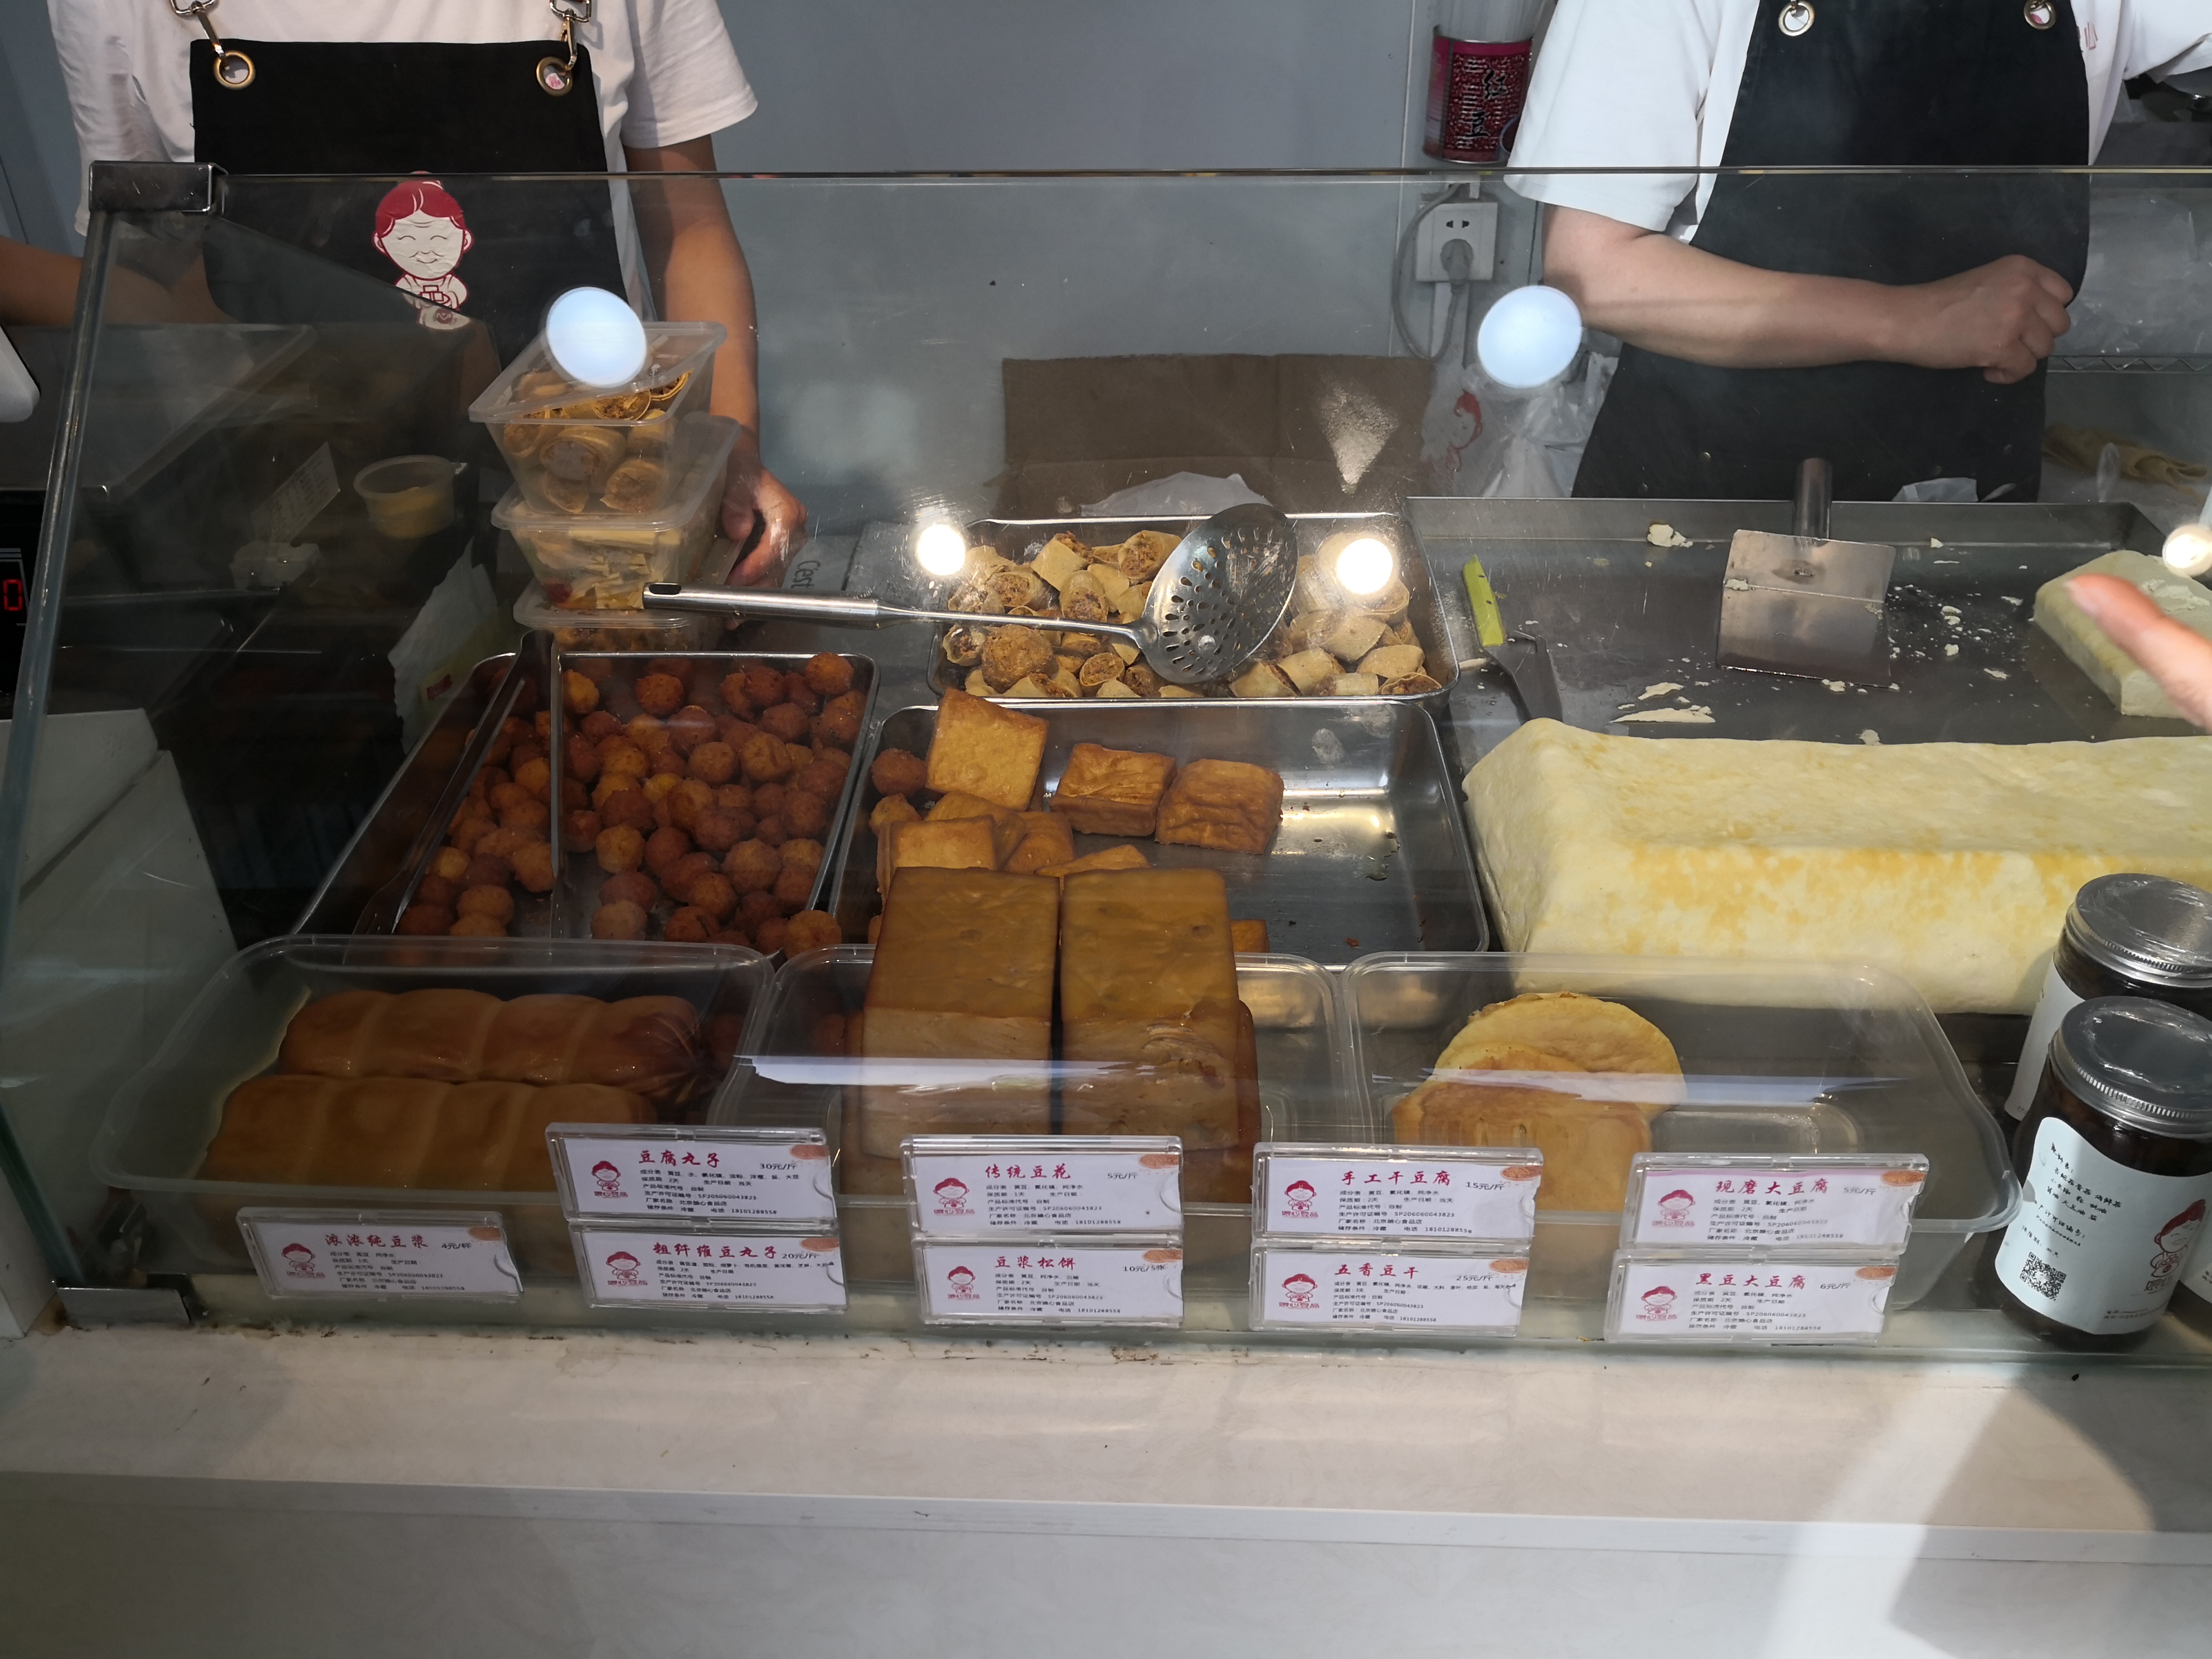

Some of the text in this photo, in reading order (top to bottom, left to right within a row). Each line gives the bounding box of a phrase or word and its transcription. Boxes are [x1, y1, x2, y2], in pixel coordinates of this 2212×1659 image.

[3, 579, 23, 611] 0
[639, 1149, 719, 1168] 豆腐丸子
[986, 1163, 1071, 1179] 传统豆花
[1342, 1170, 1504, 1190] 手工干豆腐 15元/斤
[1716, 1178, 1876, 1195] 现磨大豆腐 5元/斤
[325, 1234, 428, 1249] 浓浓纯豆浆
[653, 1242, 777, 1259] 粗纤维豆丸子
[995, 1255, 1076, 1271] 豆浆松饼
[1335, 1263, 1418, 1279] 五香豆干
[1696, 1273, 1806, 1289] 黑豆大豆腐
